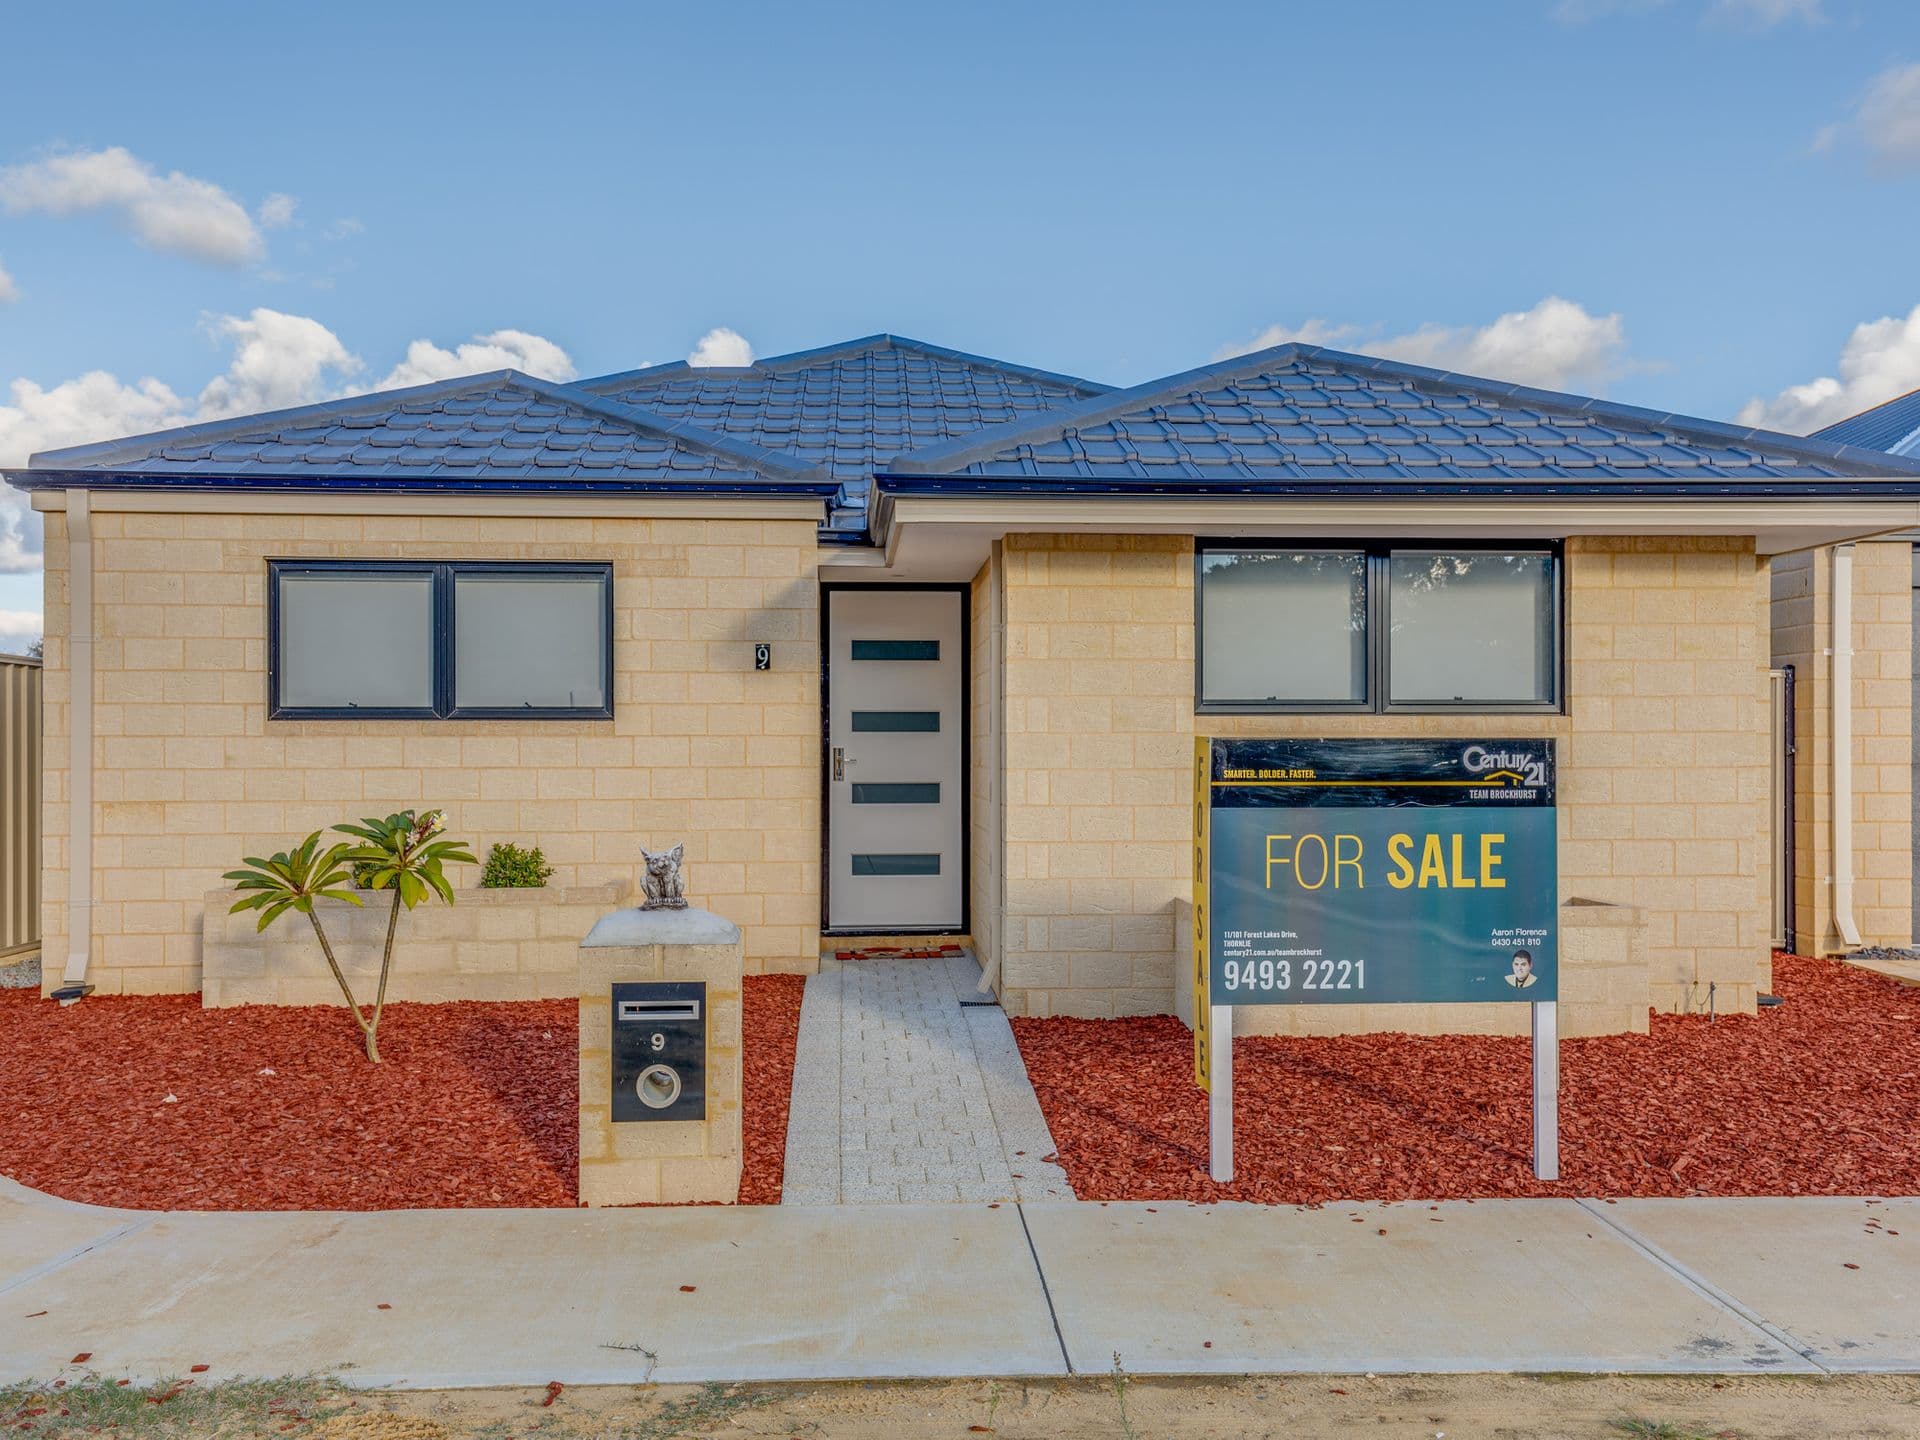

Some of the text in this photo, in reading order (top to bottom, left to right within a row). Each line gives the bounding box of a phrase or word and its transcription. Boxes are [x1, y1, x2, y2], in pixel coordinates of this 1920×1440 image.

[757, 647, 769, 667] 9
[1223, 769, 1317, 779] SMARTER. BOLDER. FASTER.
[1469, 789, 1537, 800] TEAM BROCKHURST
[1196, 756, 1204, 883] FOR
[1265, 833, 1507, 889] FOR SALE
[1244, 931, 1263, 939] Forest
[1263, 931, 1280, 939] Lakes
[1491, 928, 1514, 936] Aaron
[1223, 940, 1252, 948] THORNLIE
[1491, 938, 1541, 946] 0430 451 810
[1224, 960, 1365, 990] 9493 2221
[650, 1032, 666, 1052] 9
